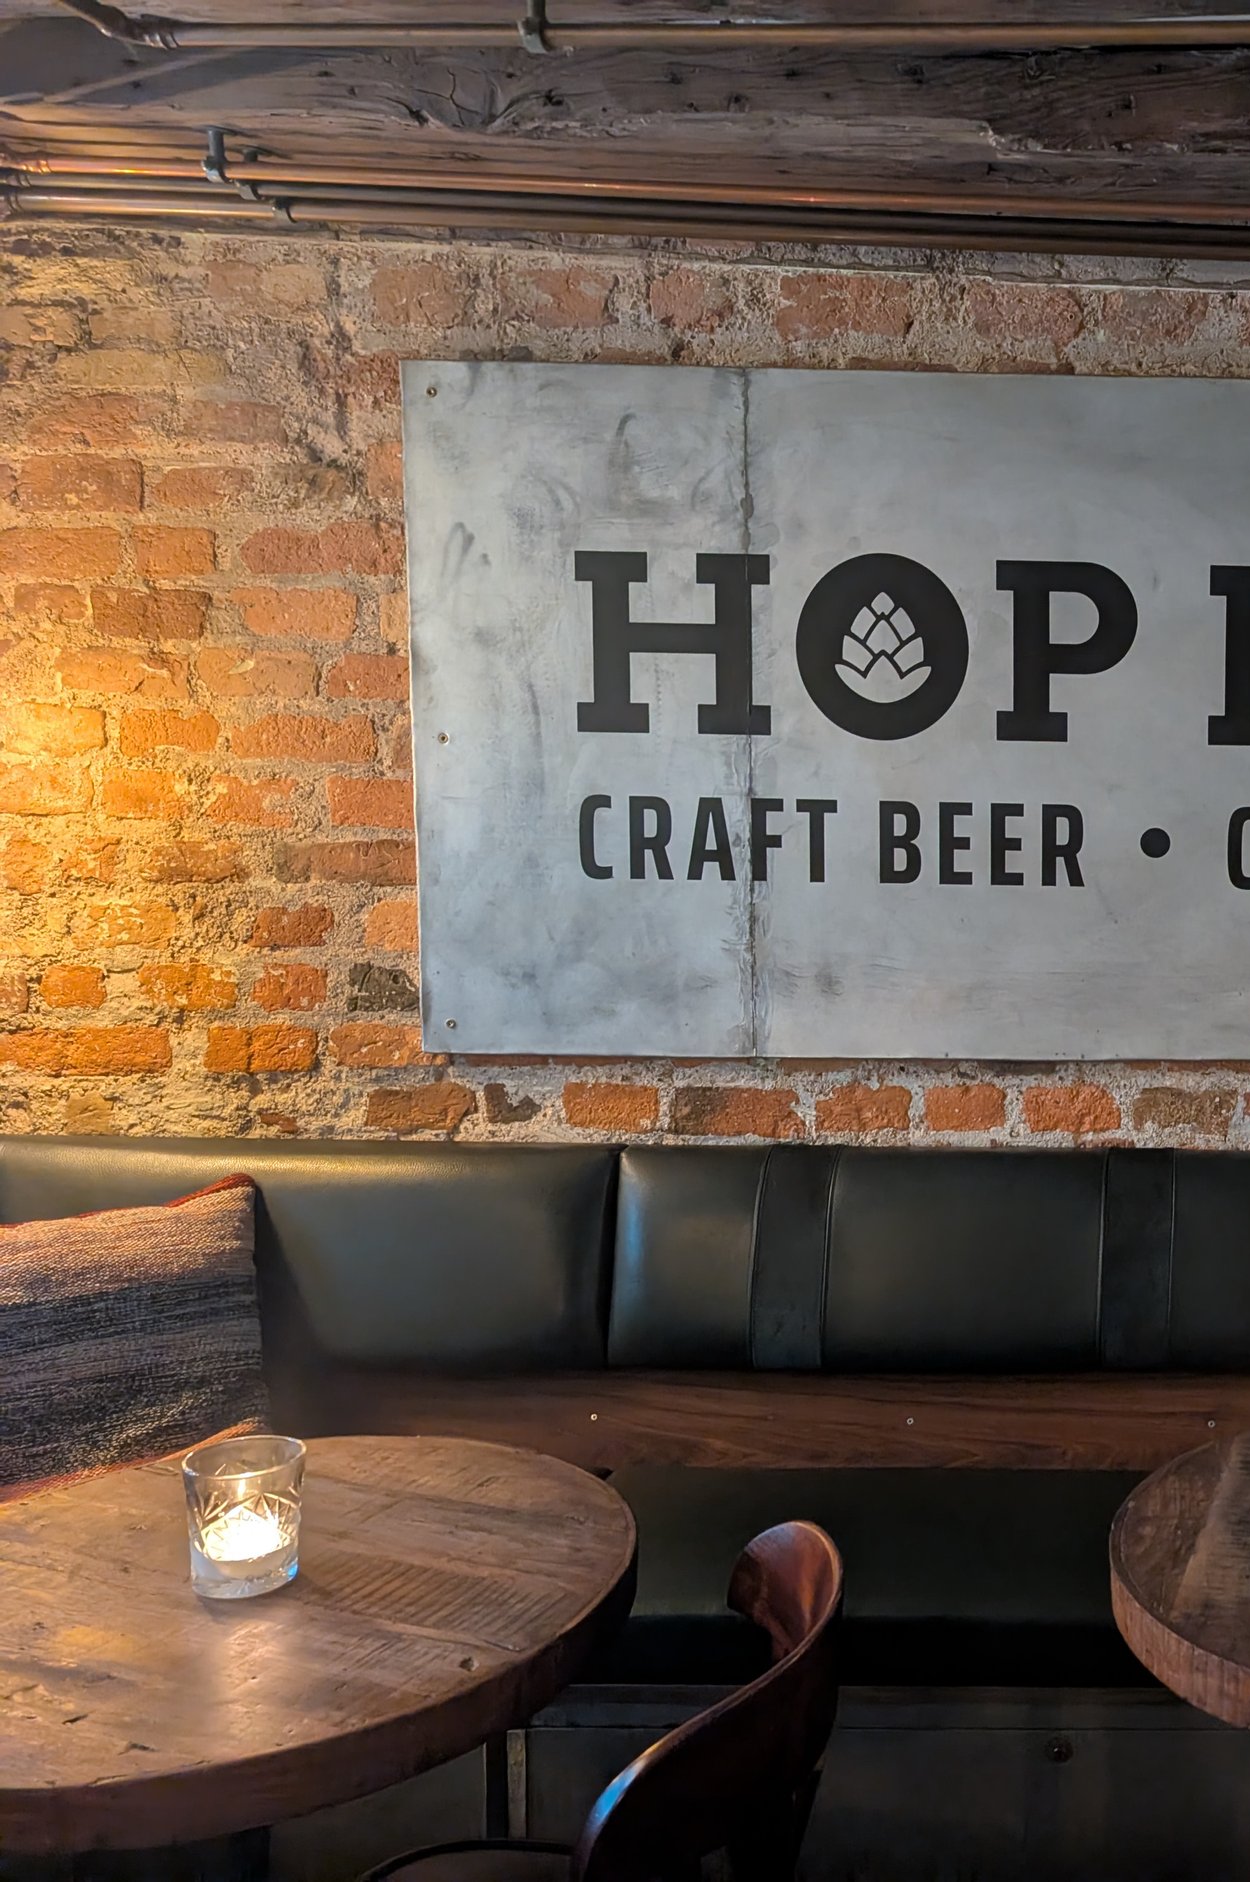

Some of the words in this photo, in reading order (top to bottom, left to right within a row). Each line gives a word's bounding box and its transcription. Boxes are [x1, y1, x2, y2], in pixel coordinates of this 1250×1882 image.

[574, 550, 1139, 743] HOP
[579, 794, 838, 884] CRAFT
[879, 800, 1085, 888] BEER
